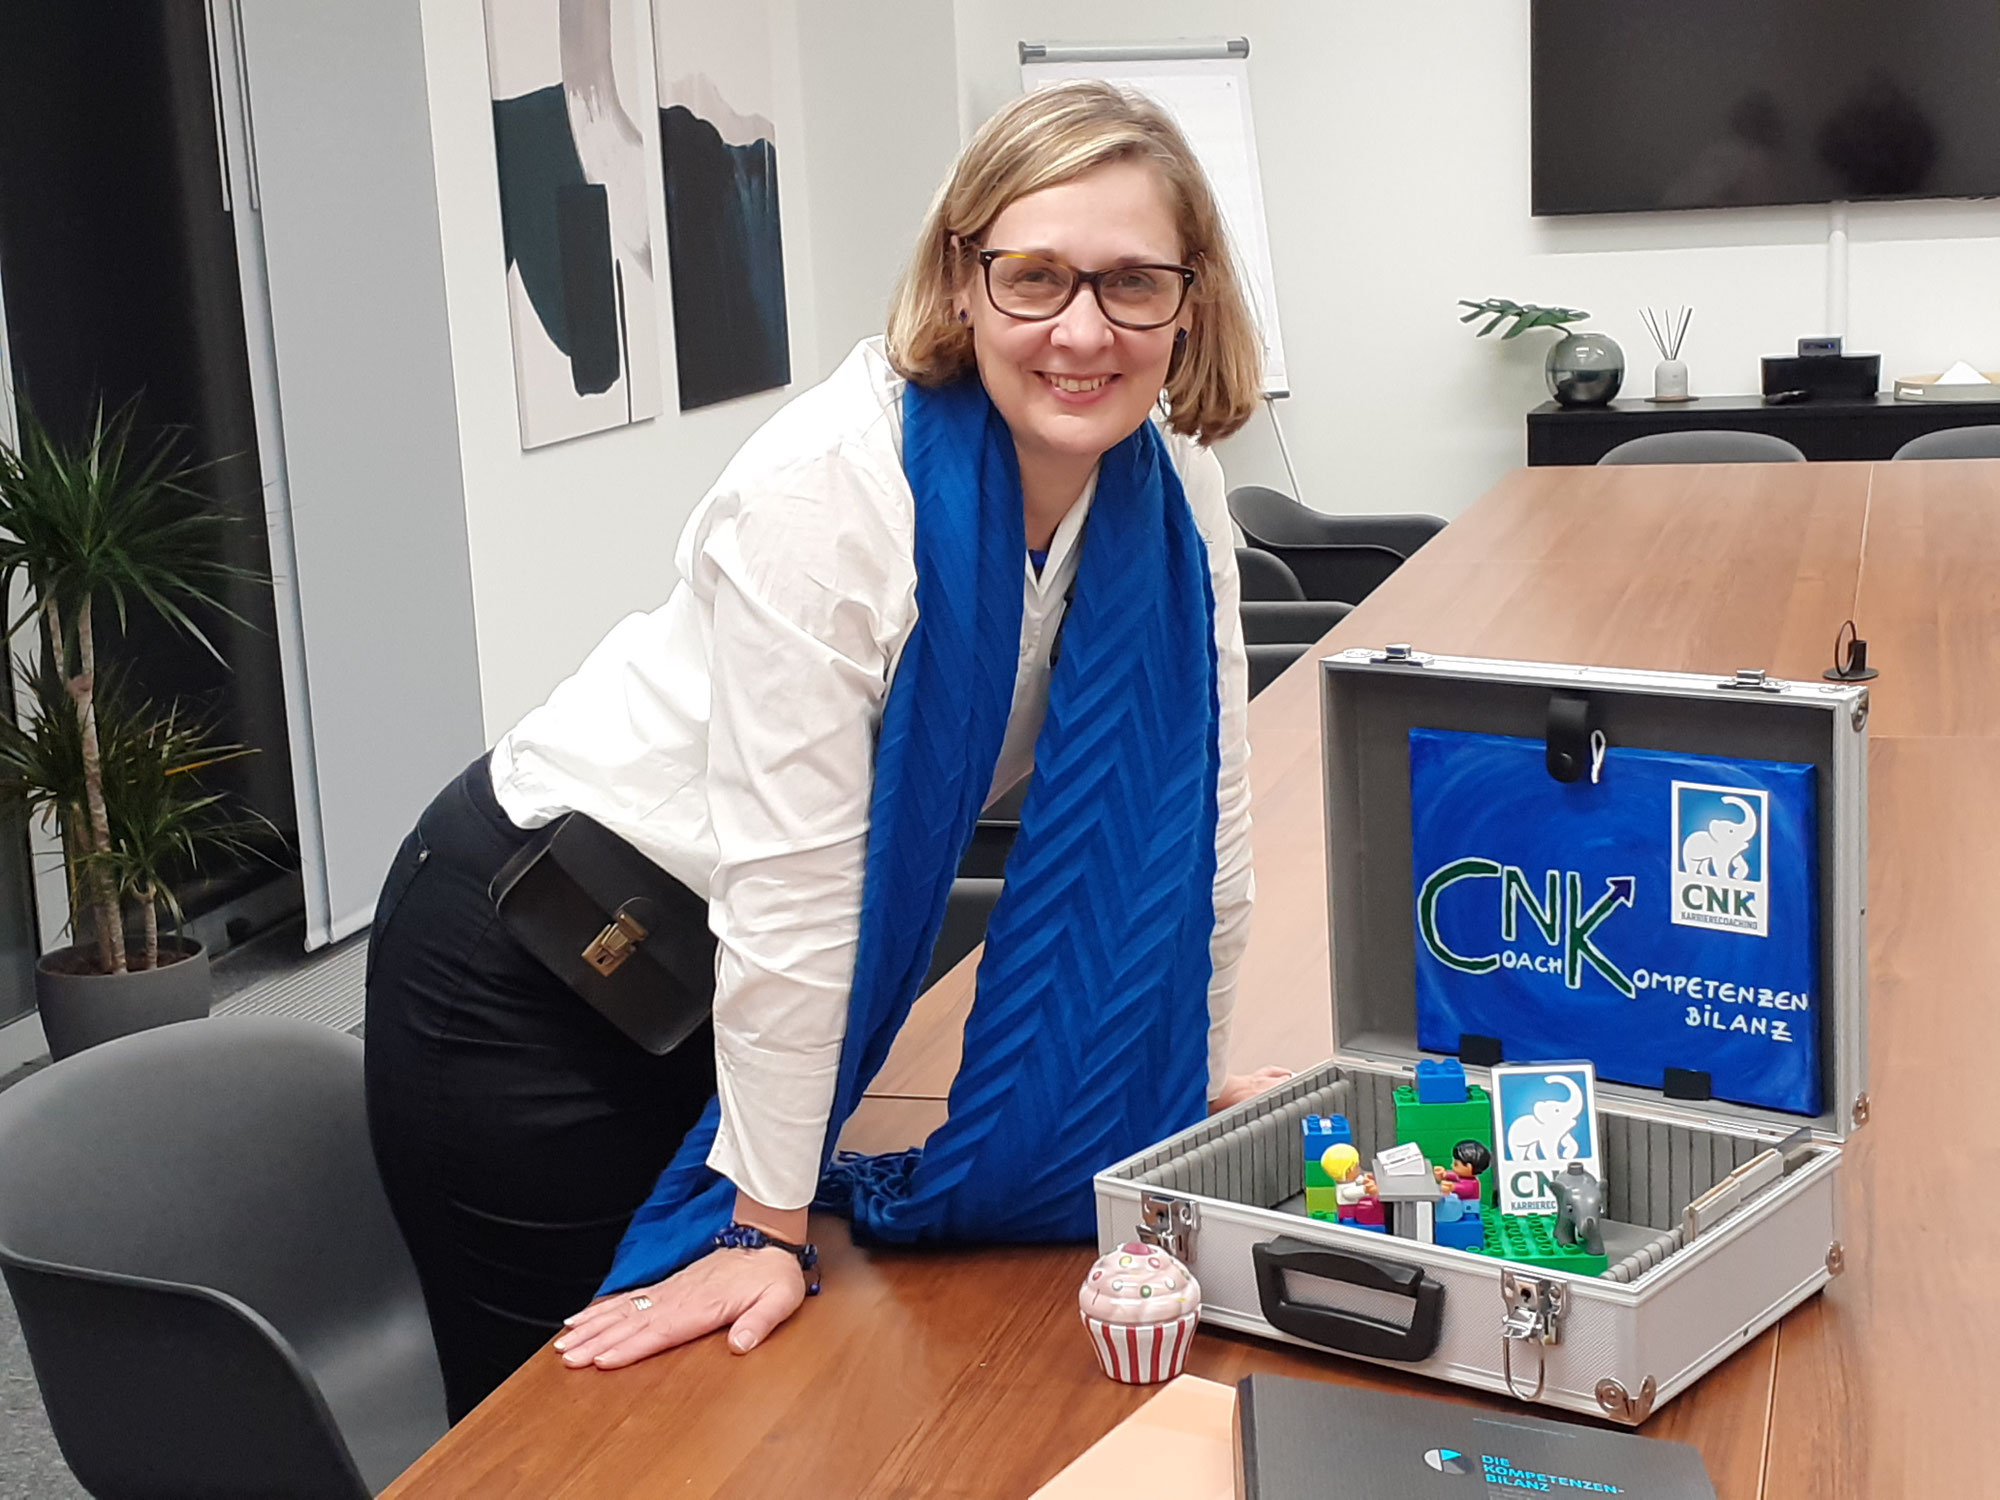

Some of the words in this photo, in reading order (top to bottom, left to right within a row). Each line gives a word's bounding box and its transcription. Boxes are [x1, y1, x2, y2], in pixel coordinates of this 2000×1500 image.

[1682, 883, 1757, 918] CNK
[1510, 1170, 1560, 1198] CN
[1511, 1201, 1556, 1210] KARRIEREC
[1481, 1454, 1511, 1467] DIE
[1483, 1464, 1625, 1494] KOMPETENZEN-
[1485, 1473, 1551, 1492] BILANZ
